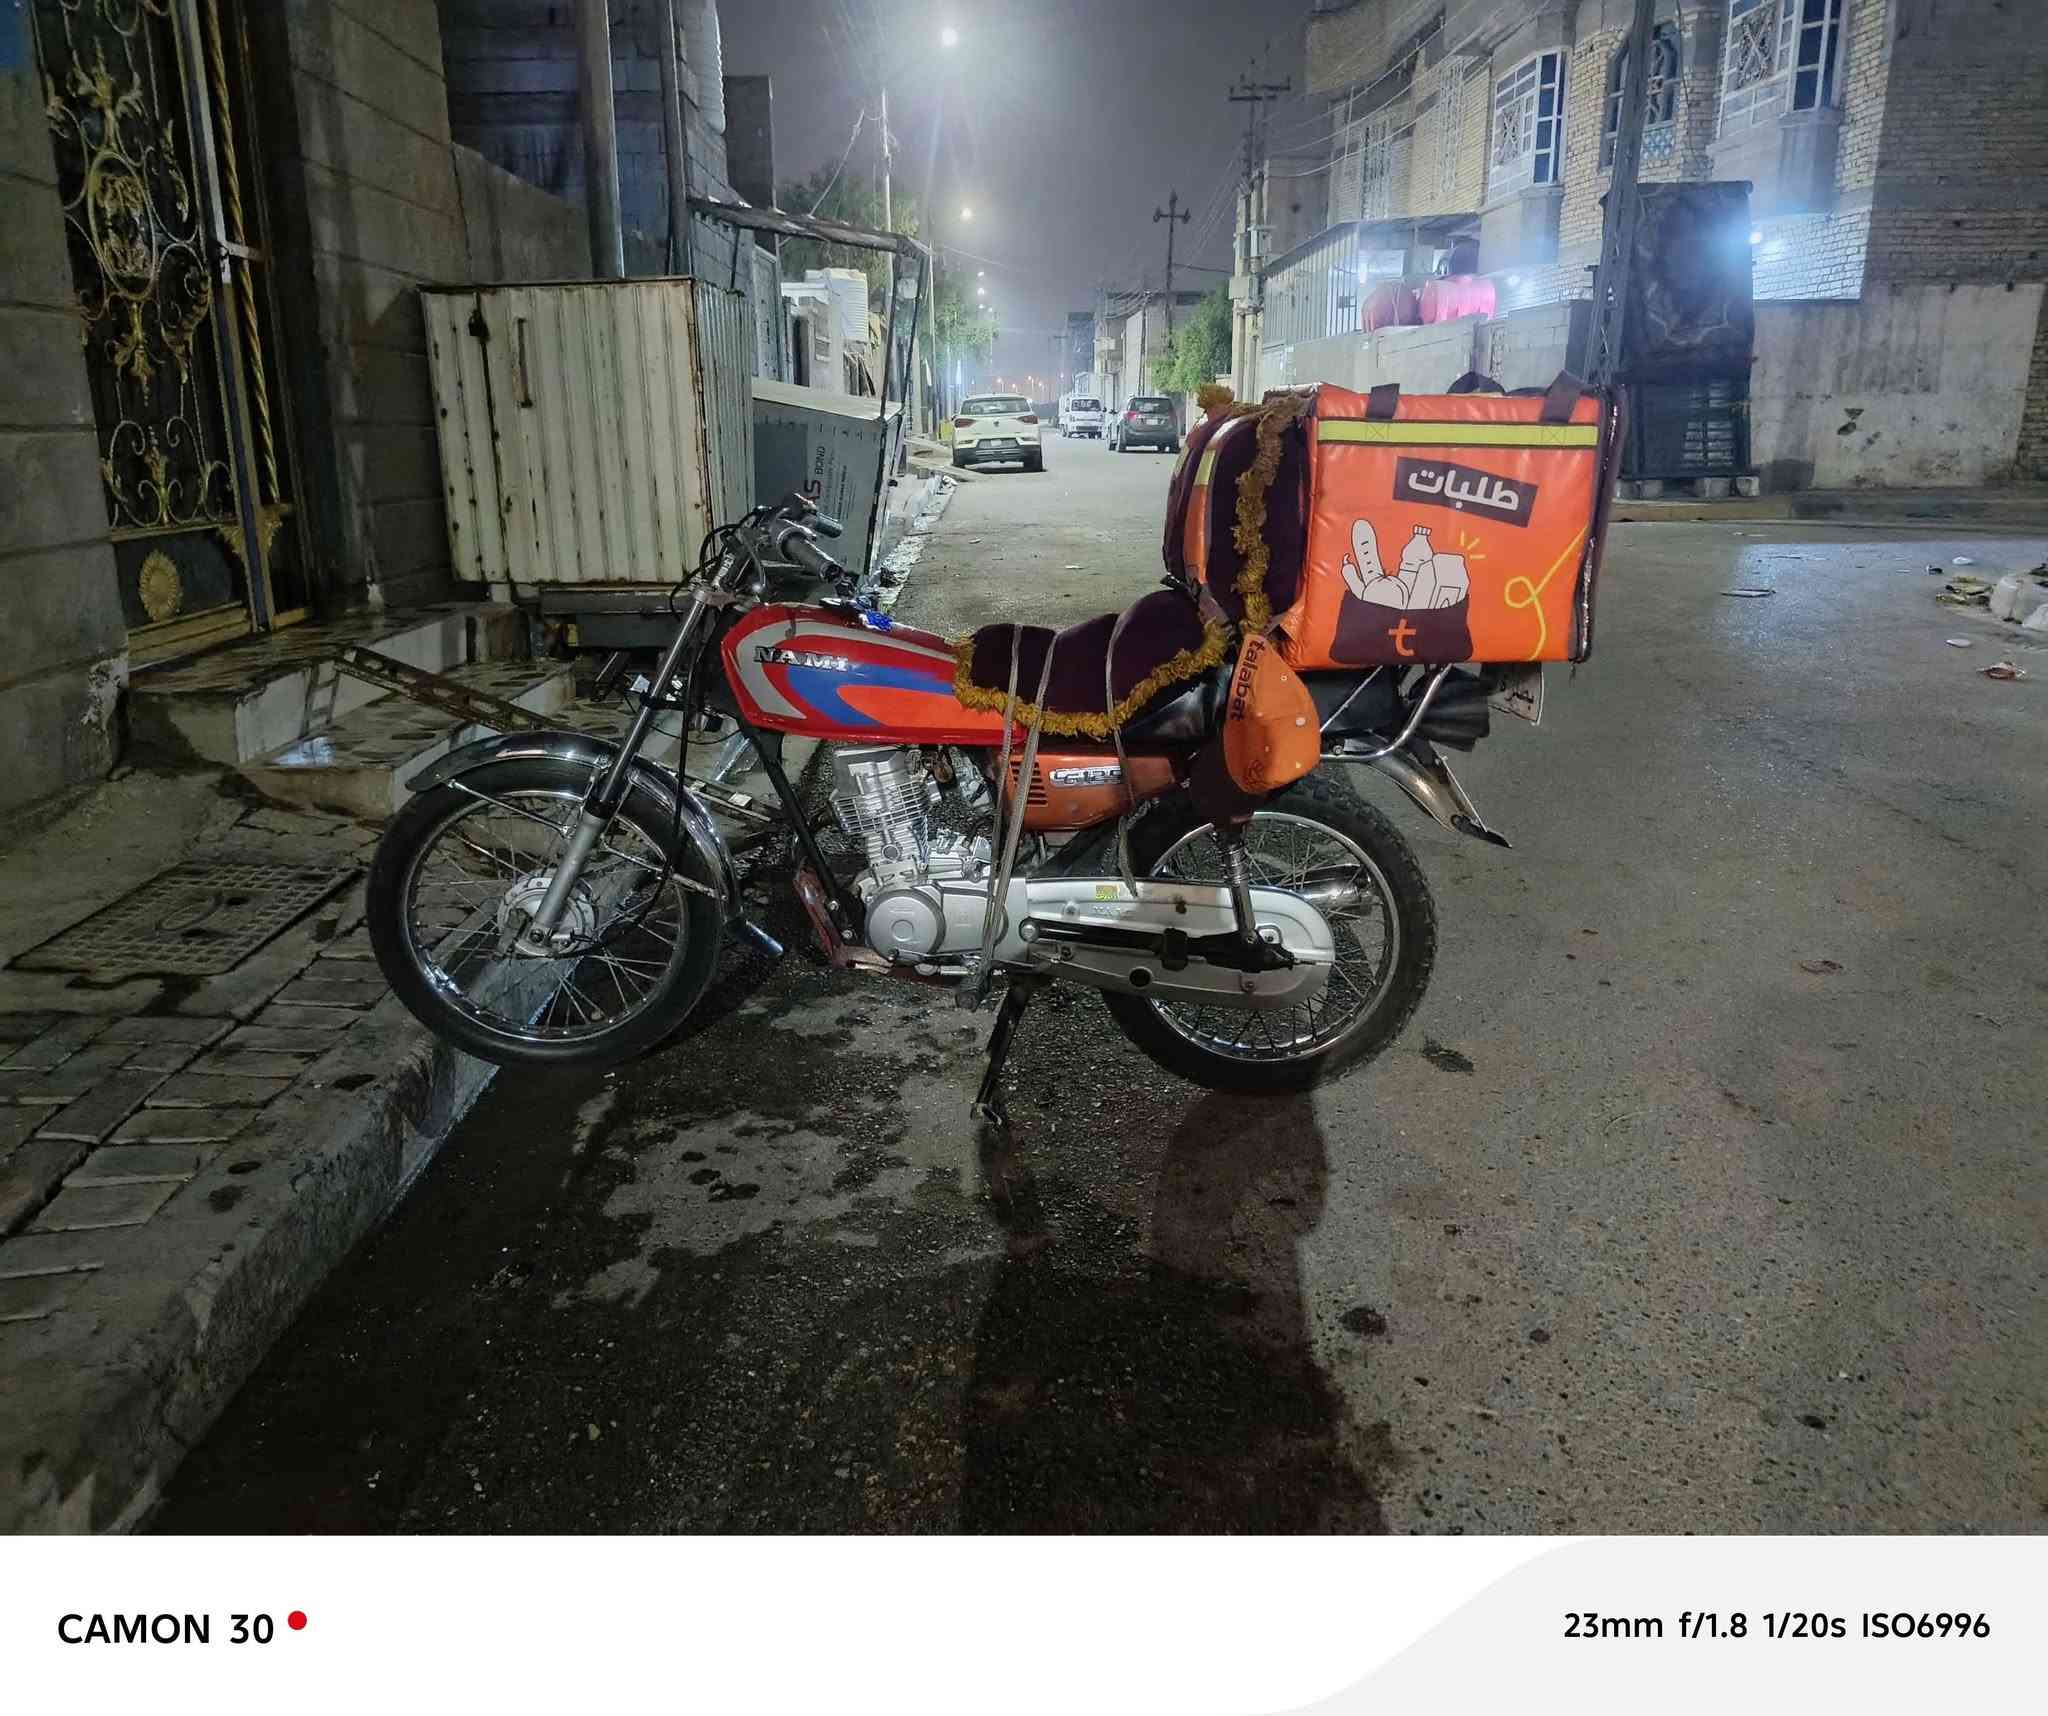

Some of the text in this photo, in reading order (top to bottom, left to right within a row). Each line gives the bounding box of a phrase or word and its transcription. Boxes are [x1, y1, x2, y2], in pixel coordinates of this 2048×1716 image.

[1408, 470, 1519, 511] طلبات
[1388, 618, 1416, 657] t
[1230, 640, 1265, 721] talabat
